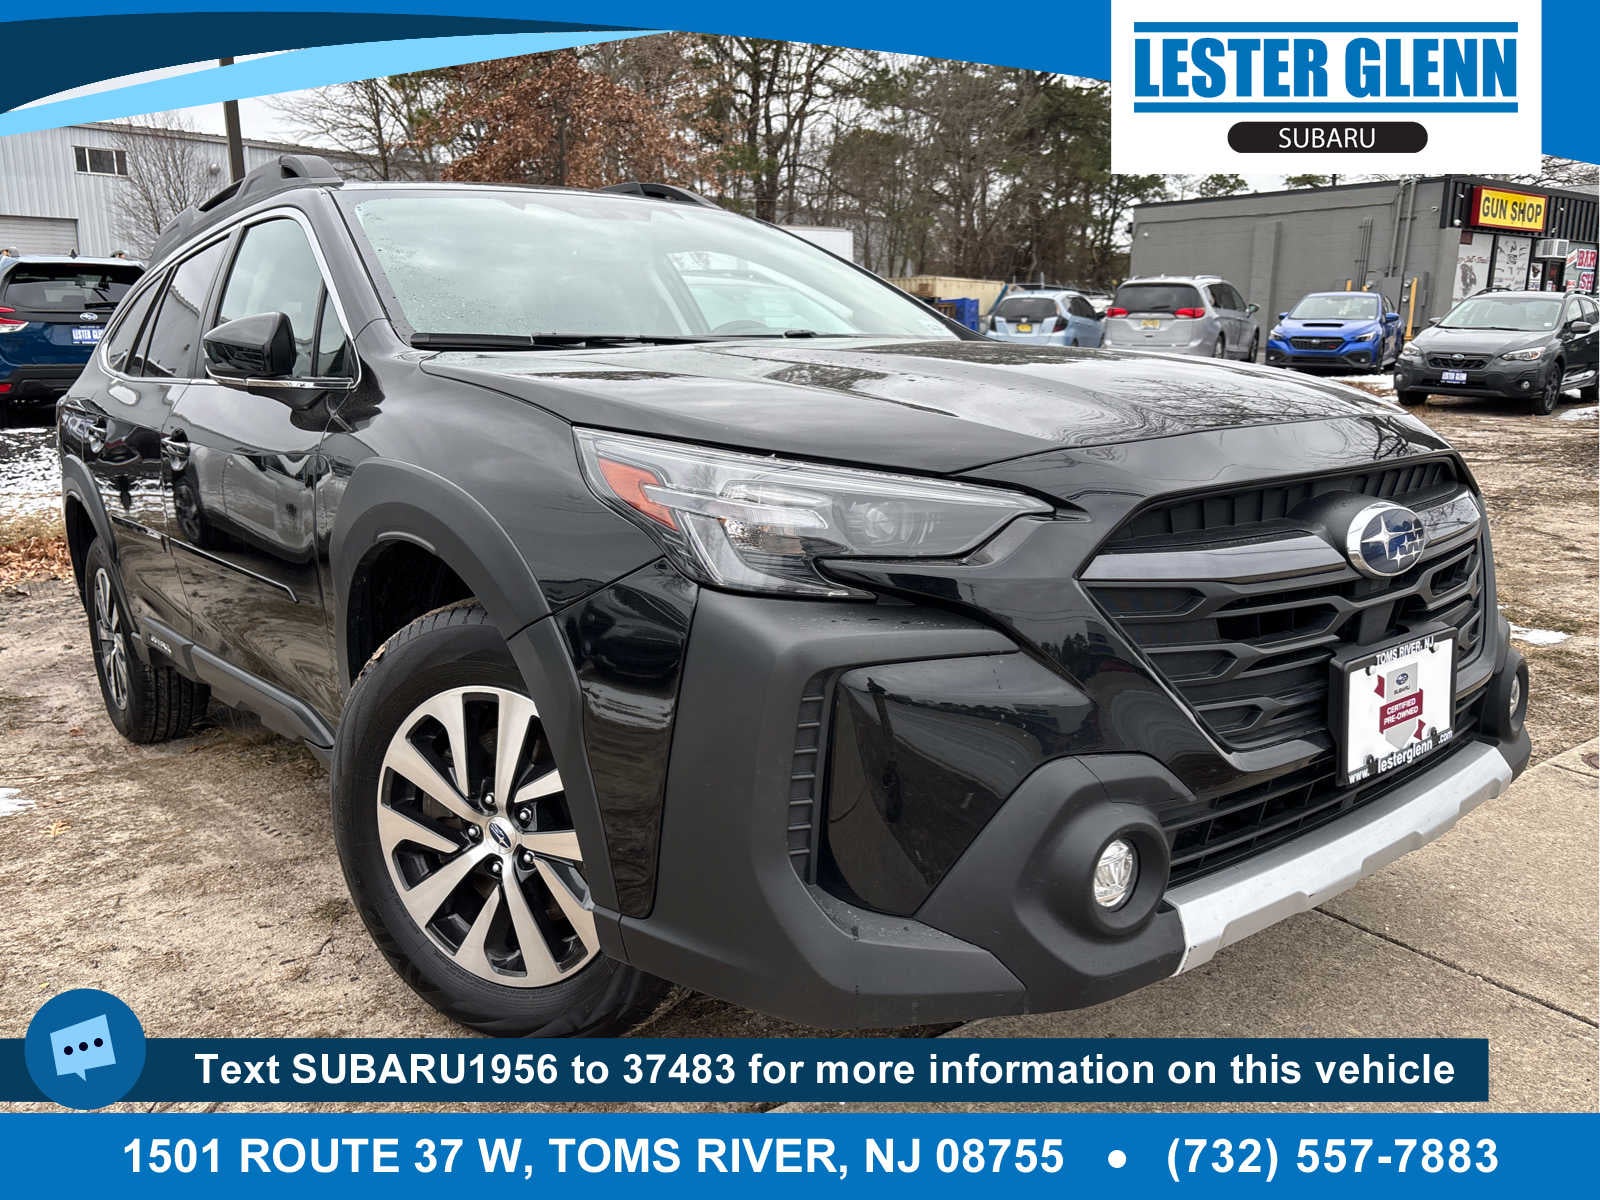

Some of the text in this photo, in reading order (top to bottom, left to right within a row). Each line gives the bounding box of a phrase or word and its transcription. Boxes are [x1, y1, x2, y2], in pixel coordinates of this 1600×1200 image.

[1482, 196, 1543, 223] GUN SHOP
[1376, 648, 1398, 665] TOMS
[1424, 635, 1434, 650] NJ
[1383, 706, 1419, 726] PRE-OWNED
[1386, 698, 1416, 715] CERTIFIED
